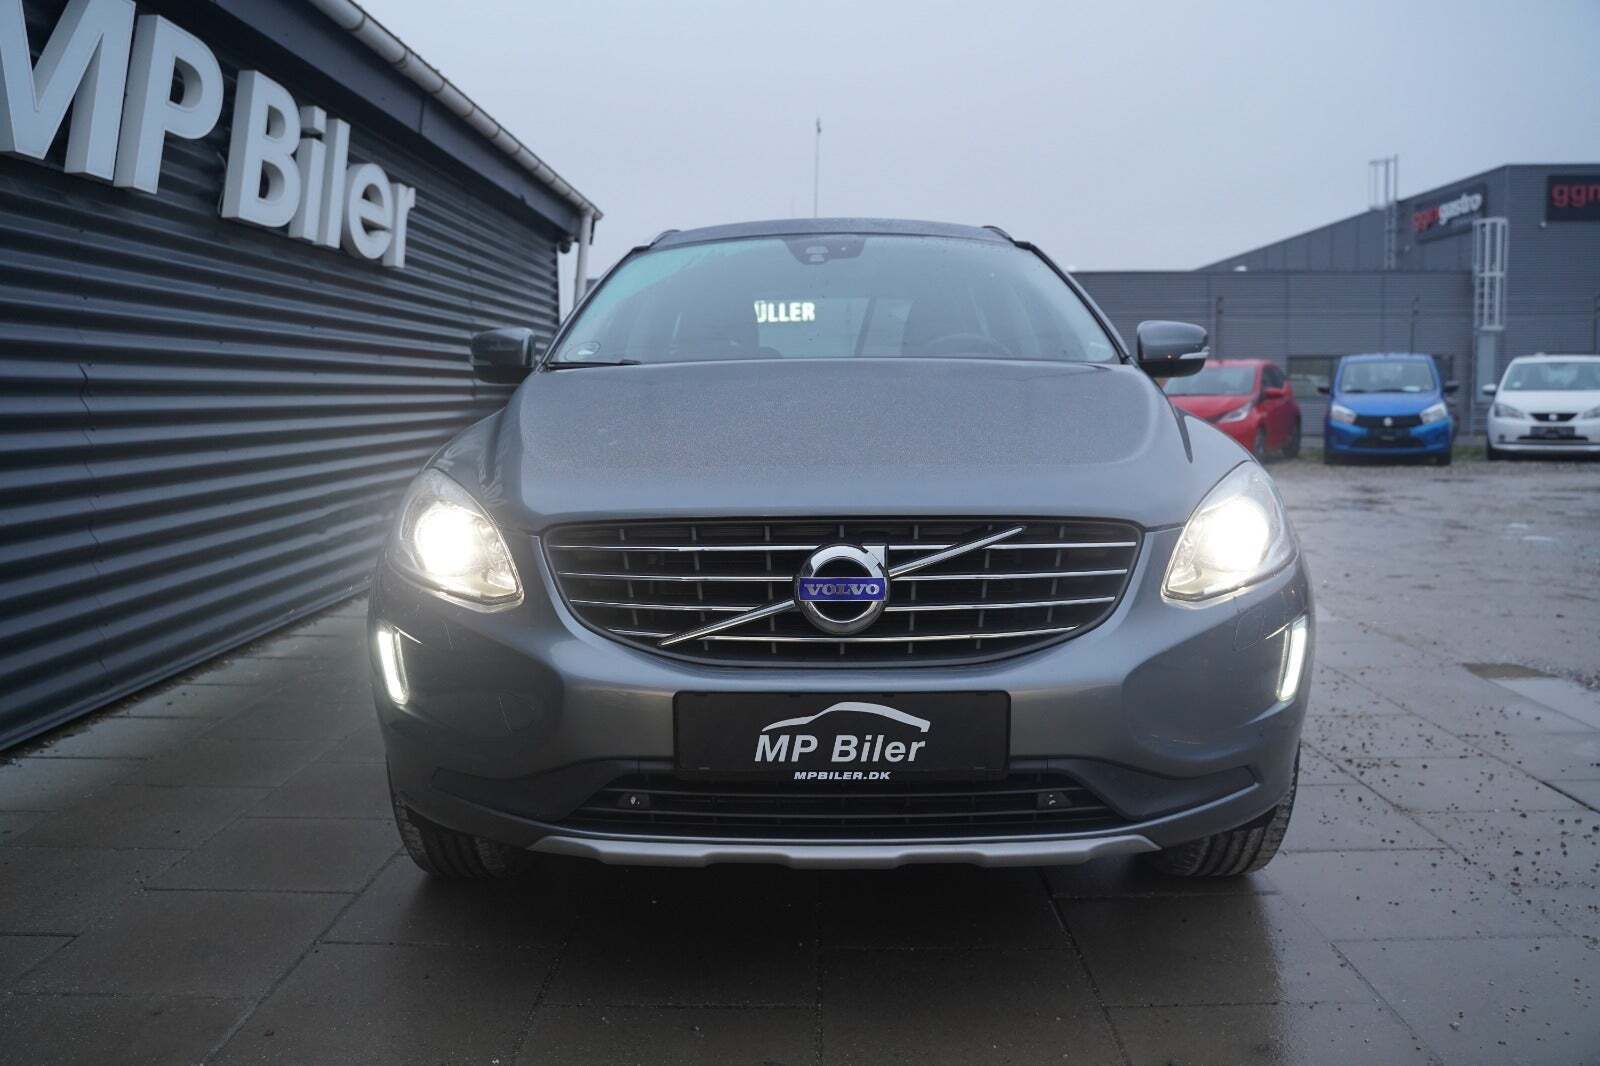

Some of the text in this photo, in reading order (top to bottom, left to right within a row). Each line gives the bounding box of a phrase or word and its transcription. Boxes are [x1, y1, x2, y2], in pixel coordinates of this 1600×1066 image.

[0, 0, 416, 268] MP Biler
[803, 583, 880, 596] VOLVO
[754, 734, 926, 763] MP Biler
[793, 771, 891, 780] MPBILER.DK
